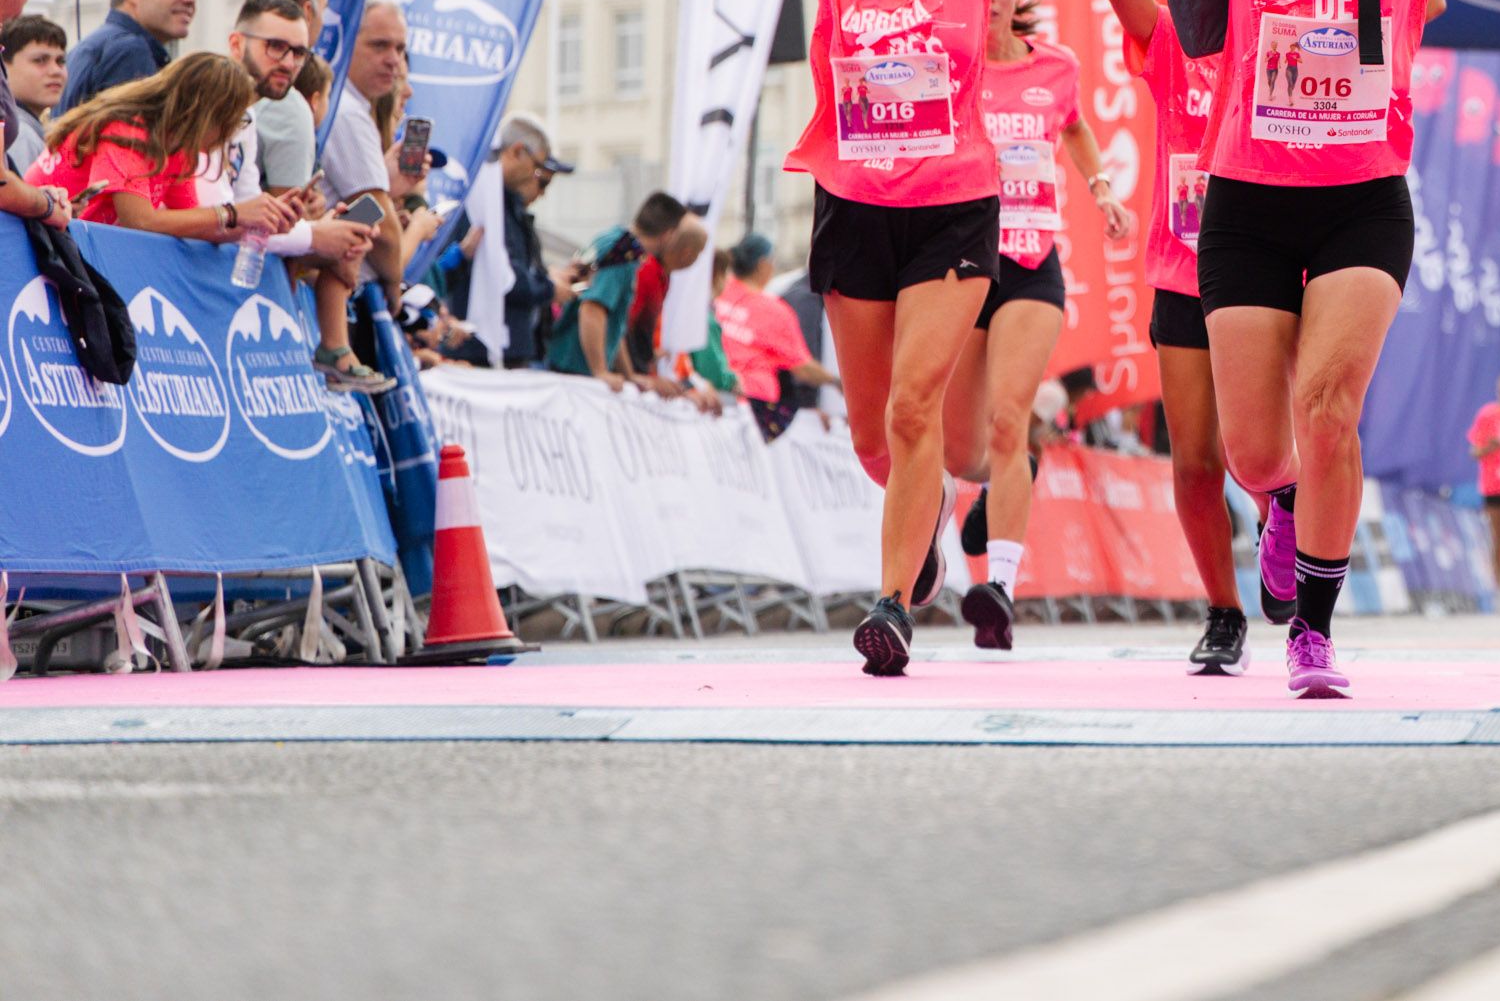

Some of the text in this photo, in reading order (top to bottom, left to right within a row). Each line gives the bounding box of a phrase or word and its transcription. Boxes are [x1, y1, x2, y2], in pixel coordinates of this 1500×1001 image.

[1272, 27, 1298, 38] SUMA
[1303, 36, 1355, 50] ASTURIANA
[867, 68, 912, 82] ASTURIANA
[1300, 76, 1352, 98] 016
[871, 101, 916, 121] 016
[1313, 101, 1338, 111] 3304
[1266, 108, 1297, 119] CARRERA
[1298, 111, 1307, 120] DE
[1308, 111, 1317, 120] LA
[1319, 112, 1342, 121] MUJER
[1346, 112, 1352, 120] A
[1352, 110, 1377, 120] CORUÑA
[847, 132, 872, 140] CARRERA
[881, 131, 889, 139] LA
[1267, 123, 1312, 137] OYSHO
[1337, 128, 1375, 138] Santander
[850, 144, 886, 154] OYSHO
[907, 142, 941, 152] Santander
[1002, 179, 1040, 197] 016
[31, 335, 73, 354] CENTRAL
[140, 346, 175, 363] CENTRAL
[134, 361, 225, 417] ASTURIANA
[503, 404, 593, 502] OYSHO
